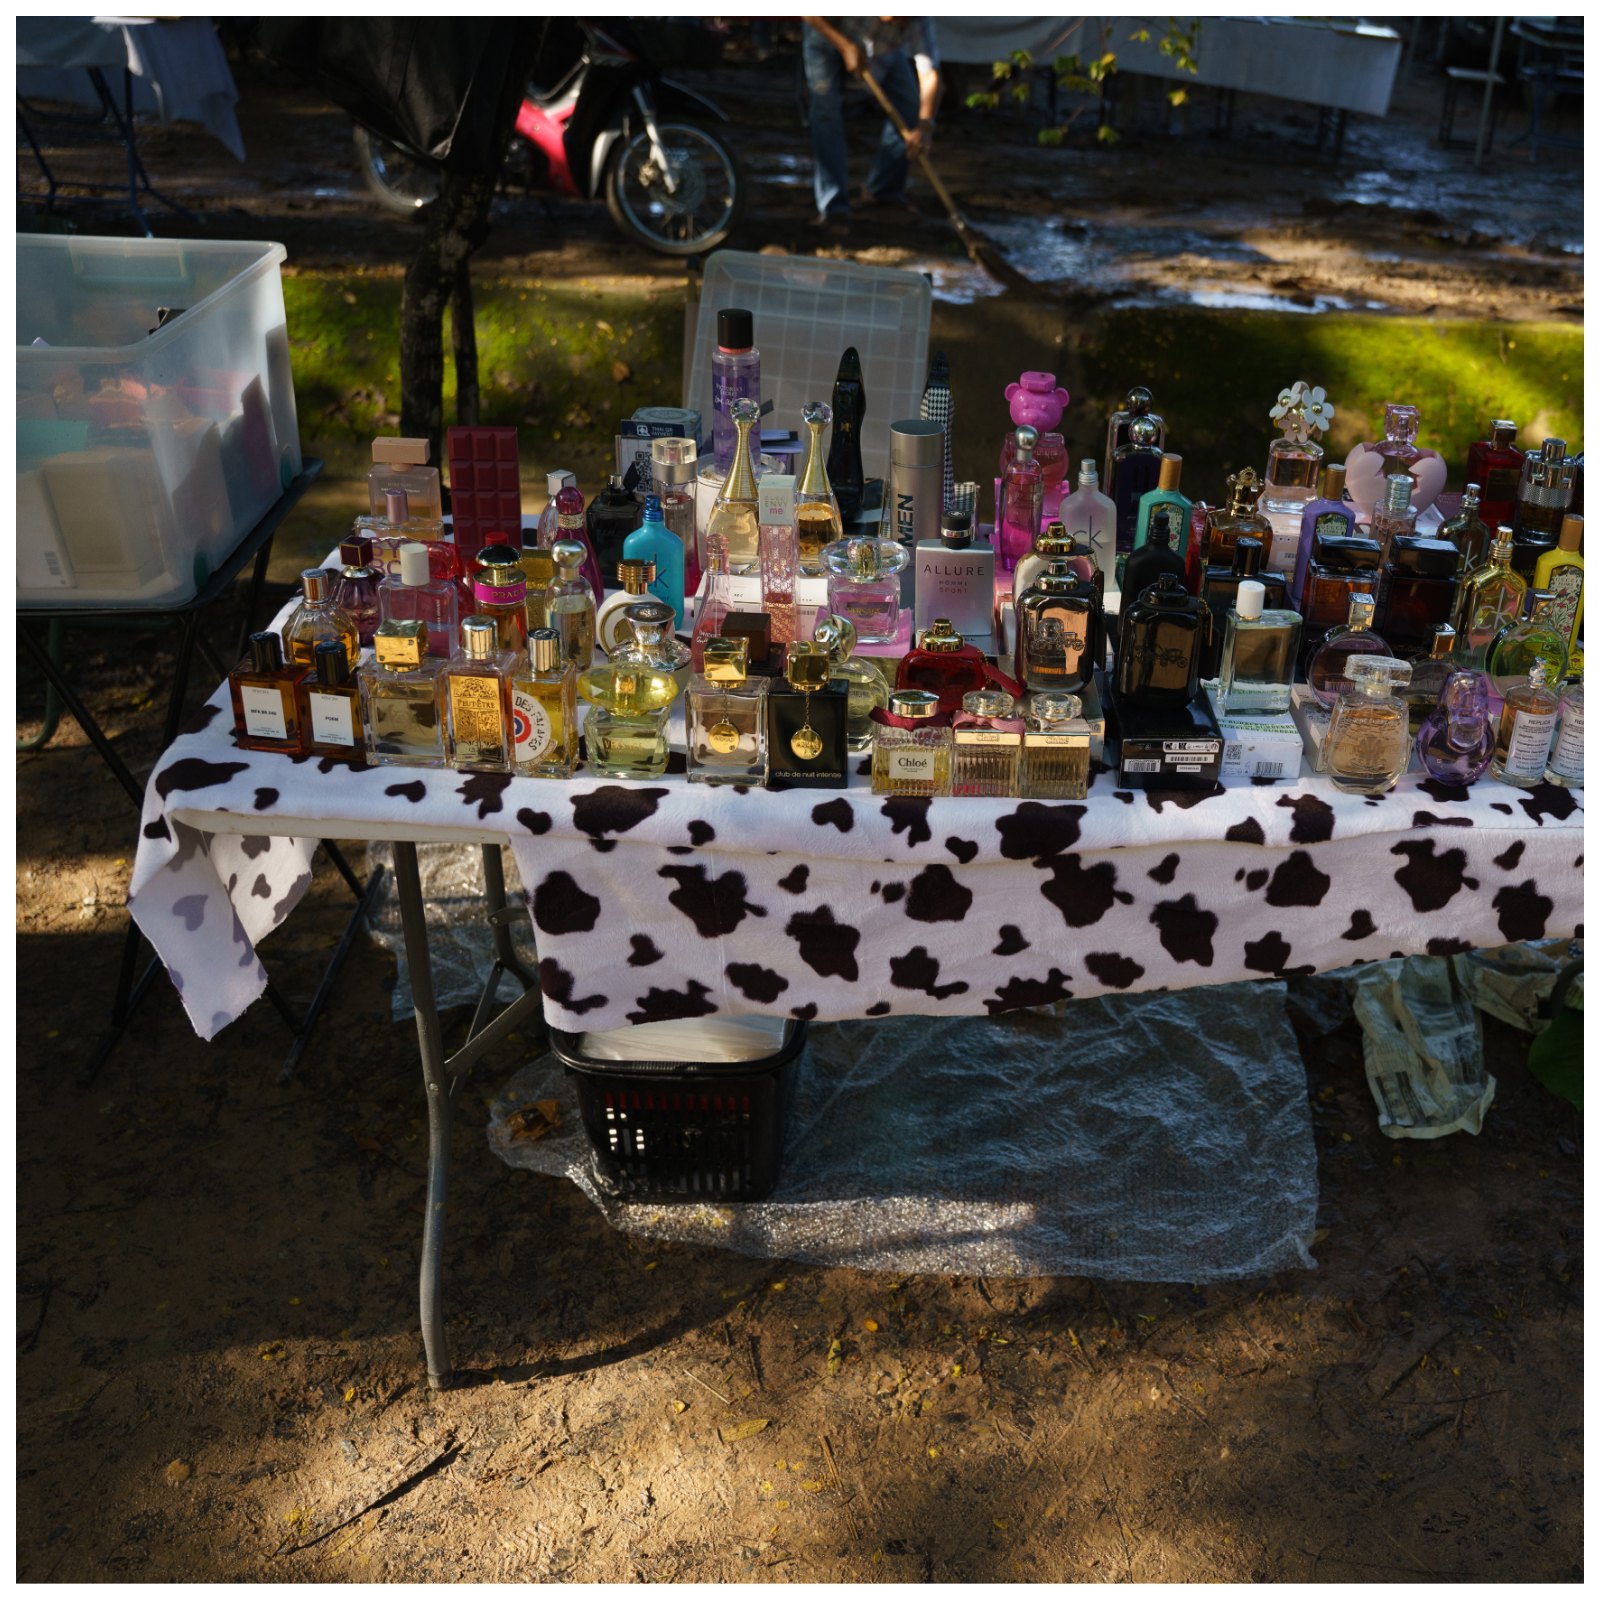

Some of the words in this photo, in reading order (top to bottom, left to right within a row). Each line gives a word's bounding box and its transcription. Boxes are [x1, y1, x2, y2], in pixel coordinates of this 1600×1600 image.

[769, 507, 784, 515] me
[898, 494, 914, 548] MEN
[923, 564, 985, 576] ALLURE
[898, 757, 928, 768] Chloé
